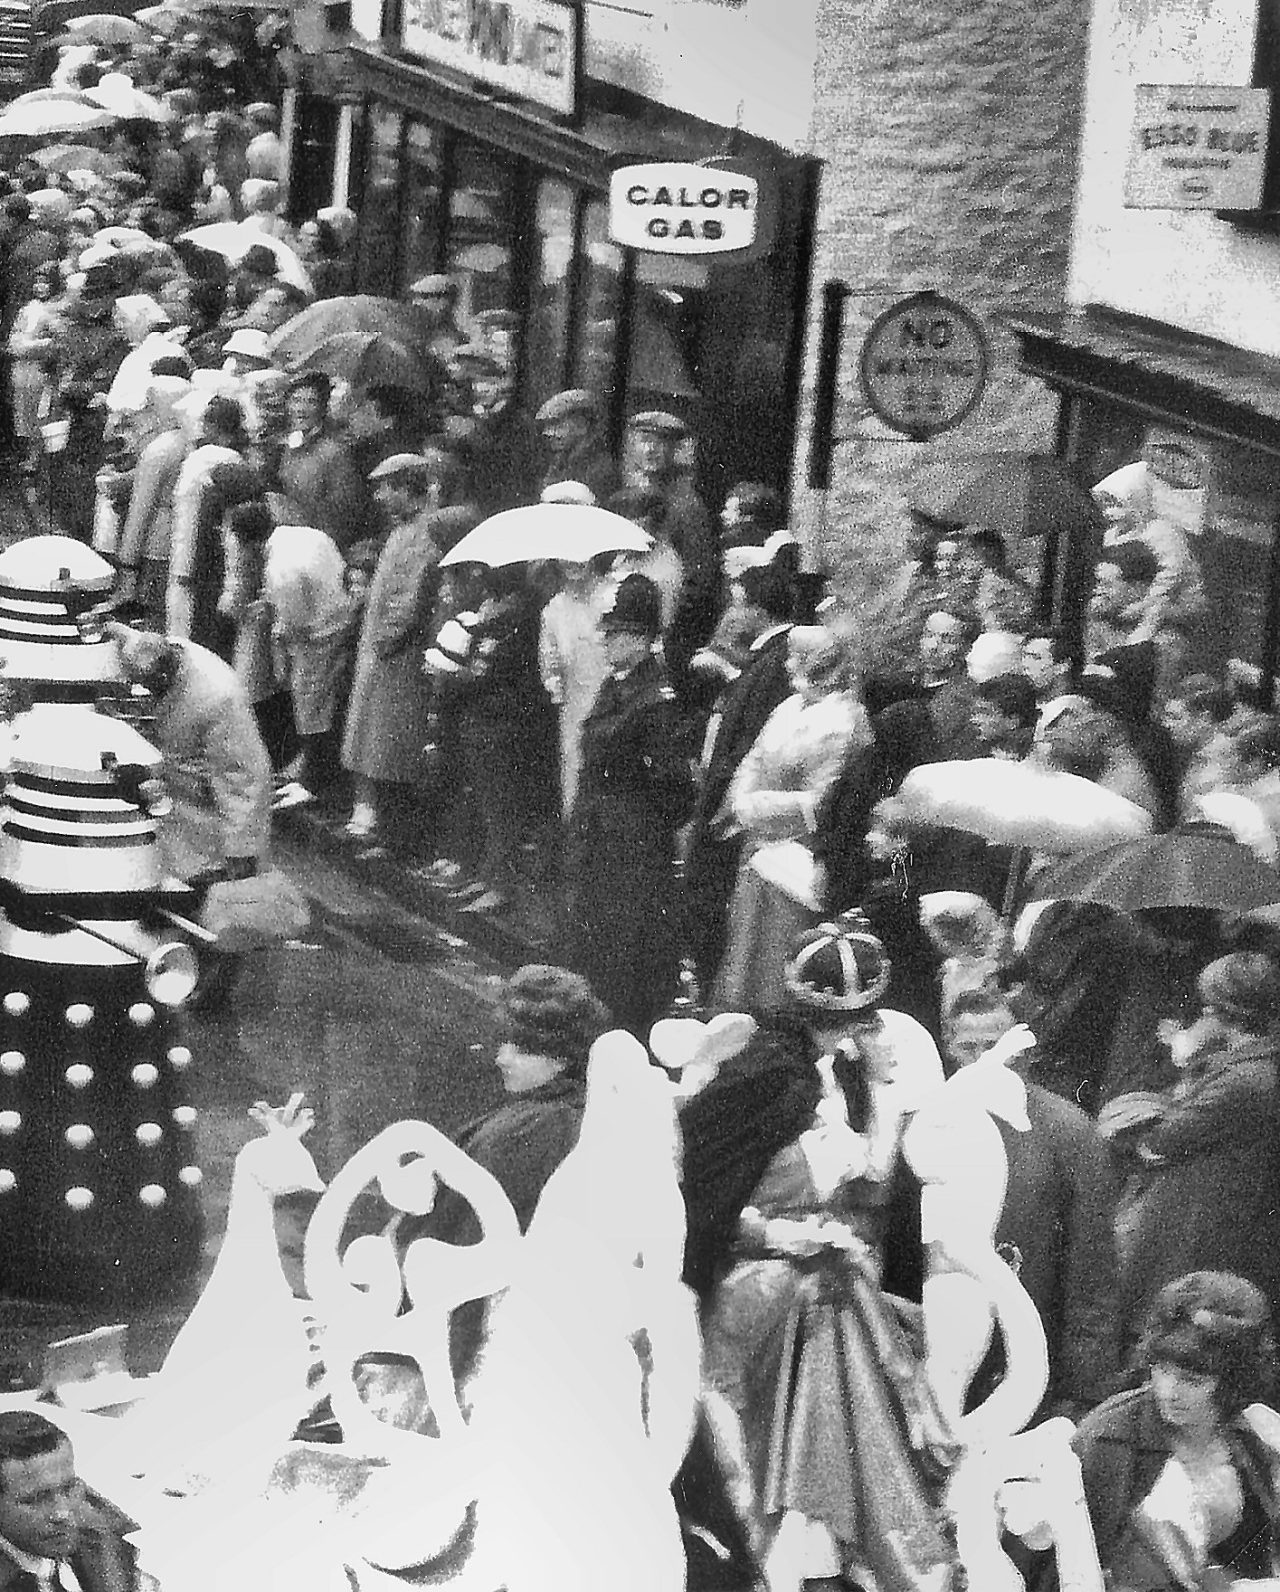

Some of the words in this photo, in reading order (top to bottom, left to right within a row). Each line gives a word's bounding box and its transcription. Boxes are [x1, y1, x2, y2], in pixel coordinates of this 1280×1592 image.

[626, 184, 751, 210] CALOR
[647, 217, 724, 240] GAS
[899, 319, 953, 350] NO
